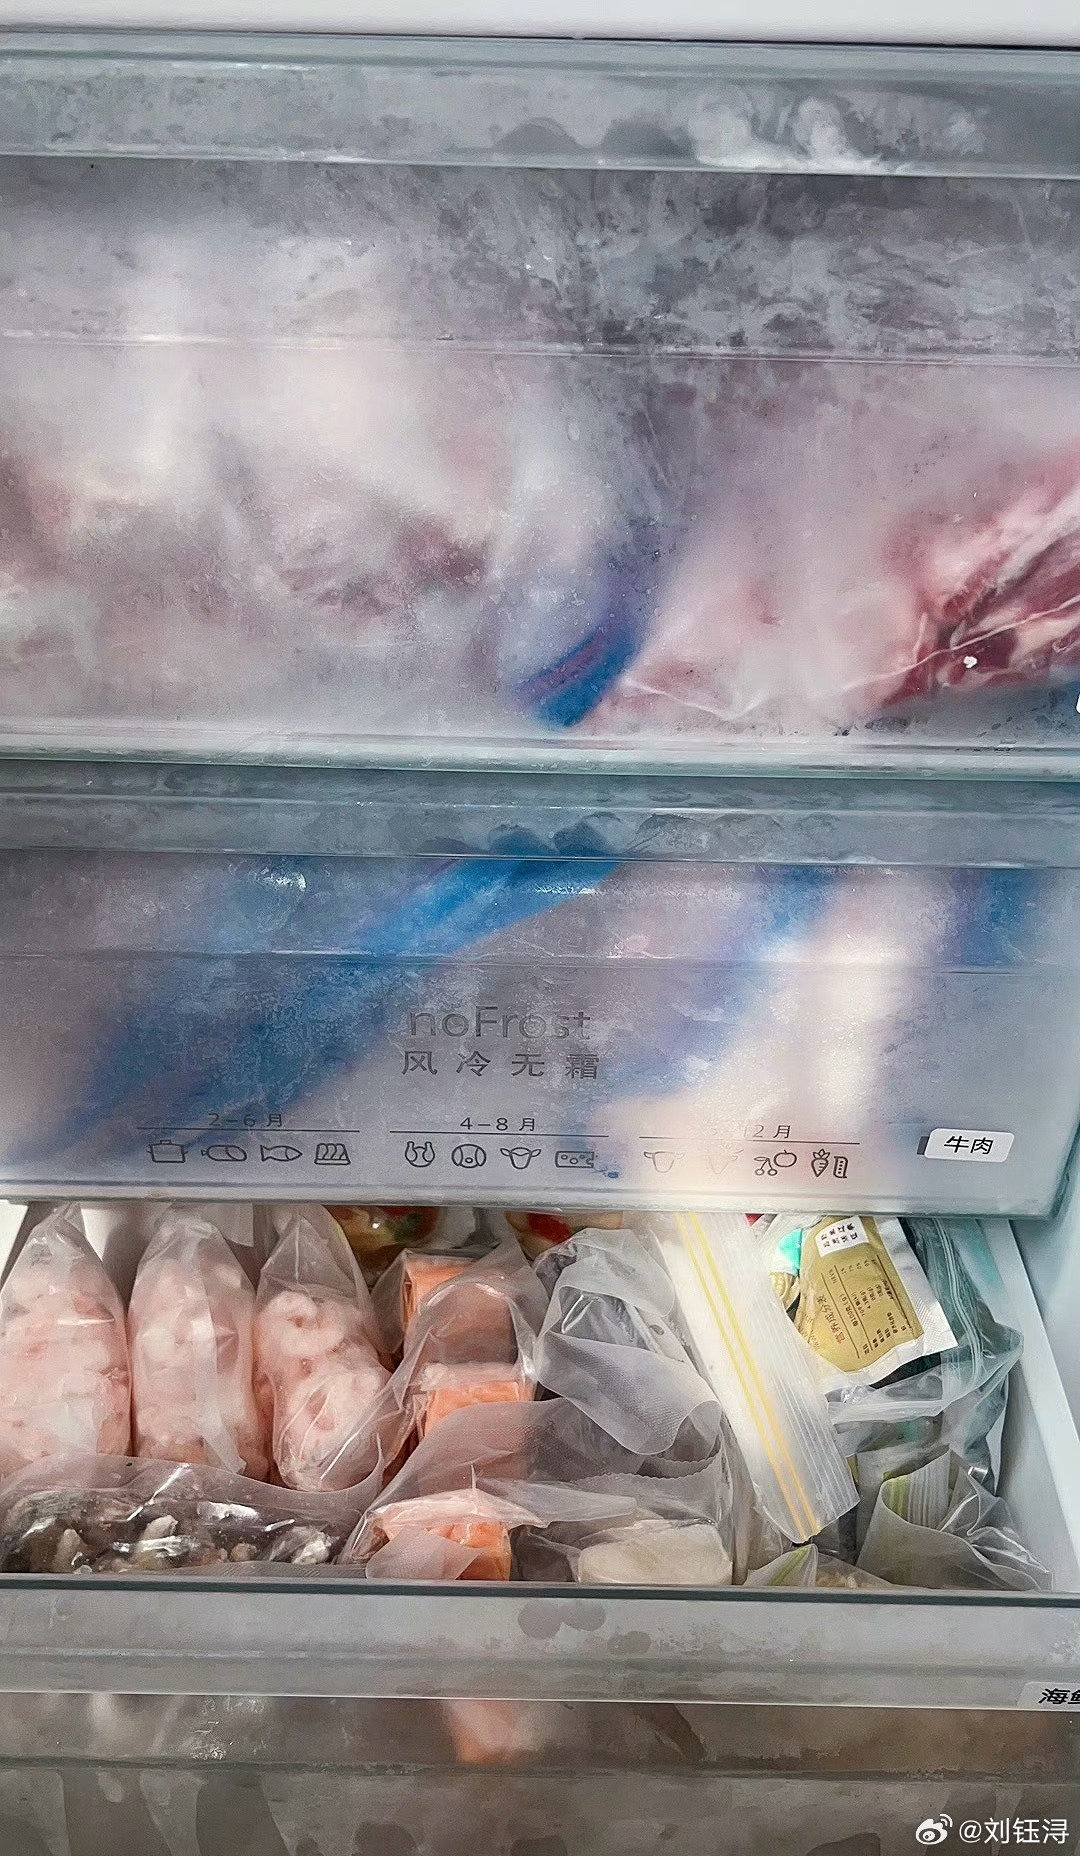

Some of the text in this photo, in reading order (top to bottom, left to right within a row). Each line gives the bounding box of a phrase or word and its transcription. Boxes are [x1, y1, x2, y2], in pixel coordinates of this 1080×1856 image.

[409, 1005, 591, 1039] noFrost
[401, 1050, 600, 1079] 风冷无霜
[944, 1135, 994, 1155] 牛肉
